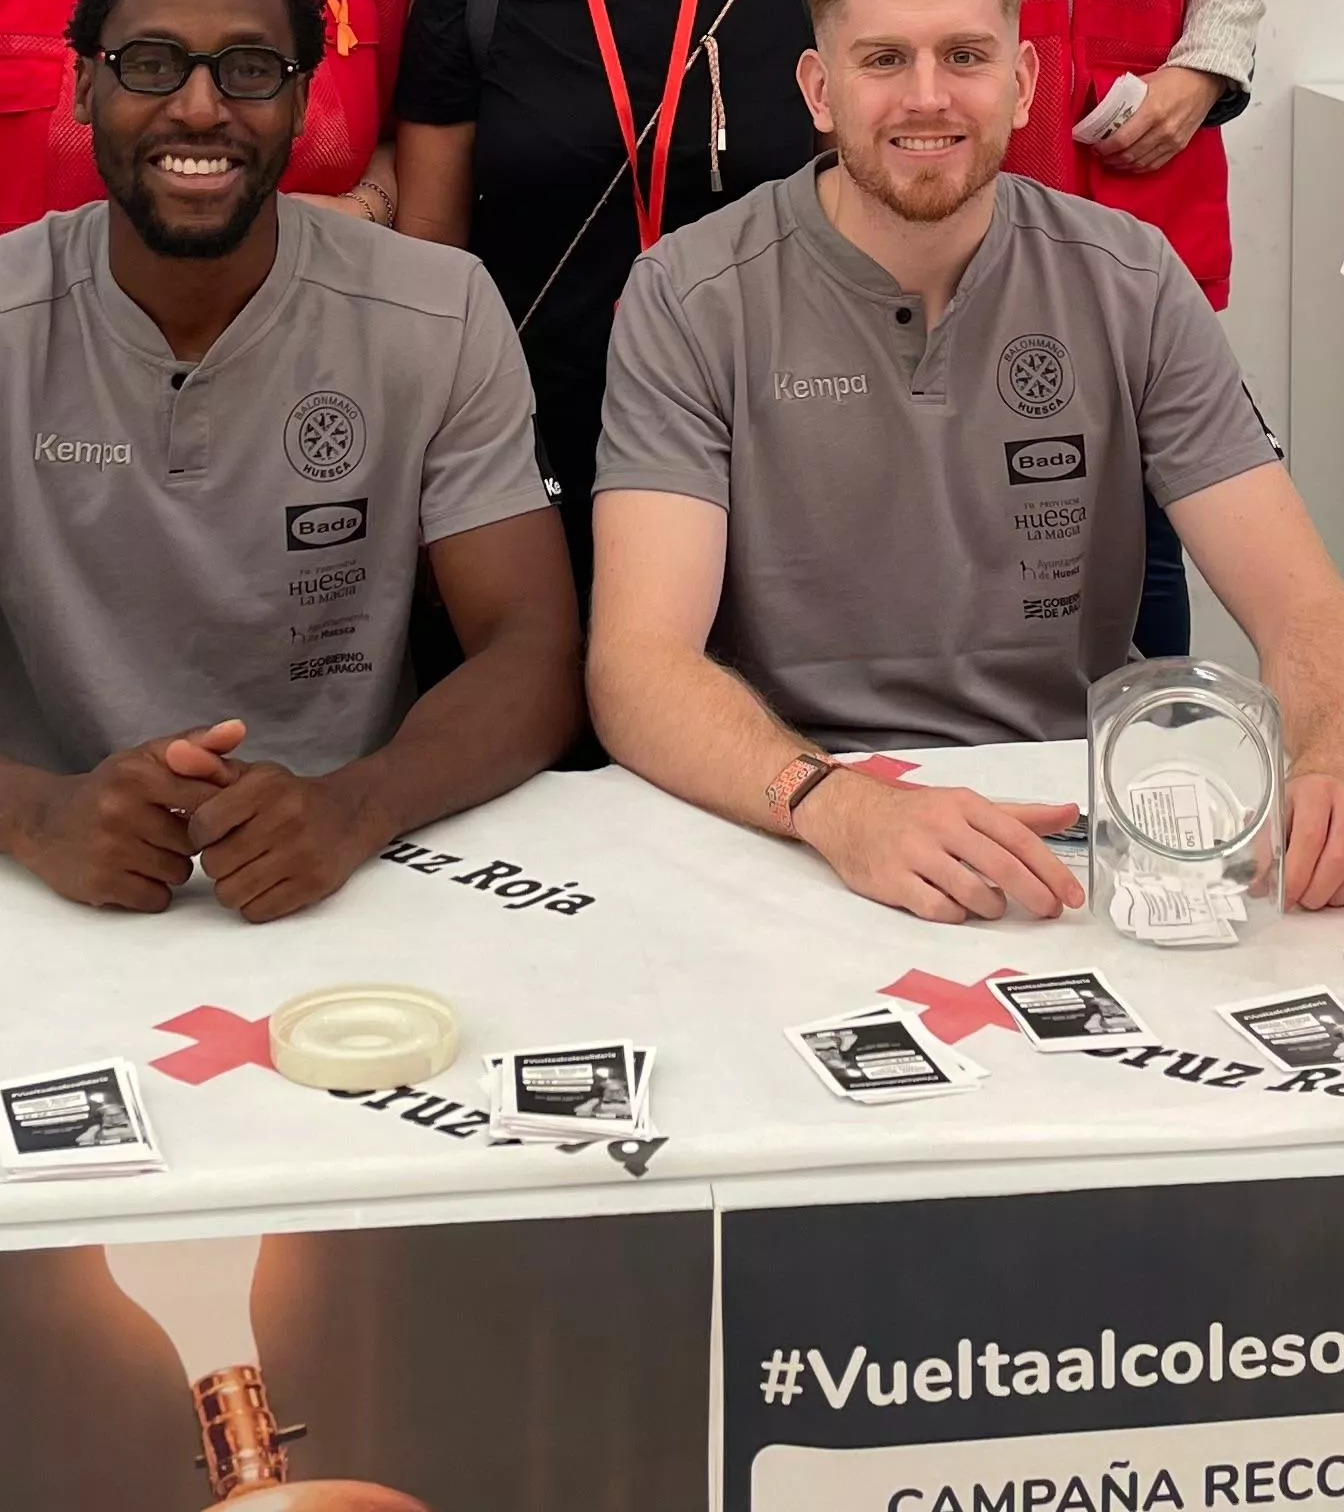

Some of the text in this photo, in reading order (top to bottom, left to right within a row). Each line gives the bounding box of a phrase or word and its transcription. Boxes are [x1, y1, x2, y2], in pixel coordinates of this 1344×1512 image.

[1003, 337, 1066, 364] BALONMANO
[773, 372, 869, 403] Kempa
[293, 394, 358, 422] BALONMANO
[1017, 396, 1065, 417] HUESCA
[33, 432, 134, 472] Kempa
[1018, 451, 1078, 470] Bada
[302, 460, 352, 480] HUESCA
[298, 514, 358, 536] Bada
[1043, 608, 1059, 619] DE
[309, 652, 365, 668] GOBIERNO
[309, 668, 324, 679] DE
[1183, 830, 1196, 848] 150
[450, 860, 597, 916] Roja
